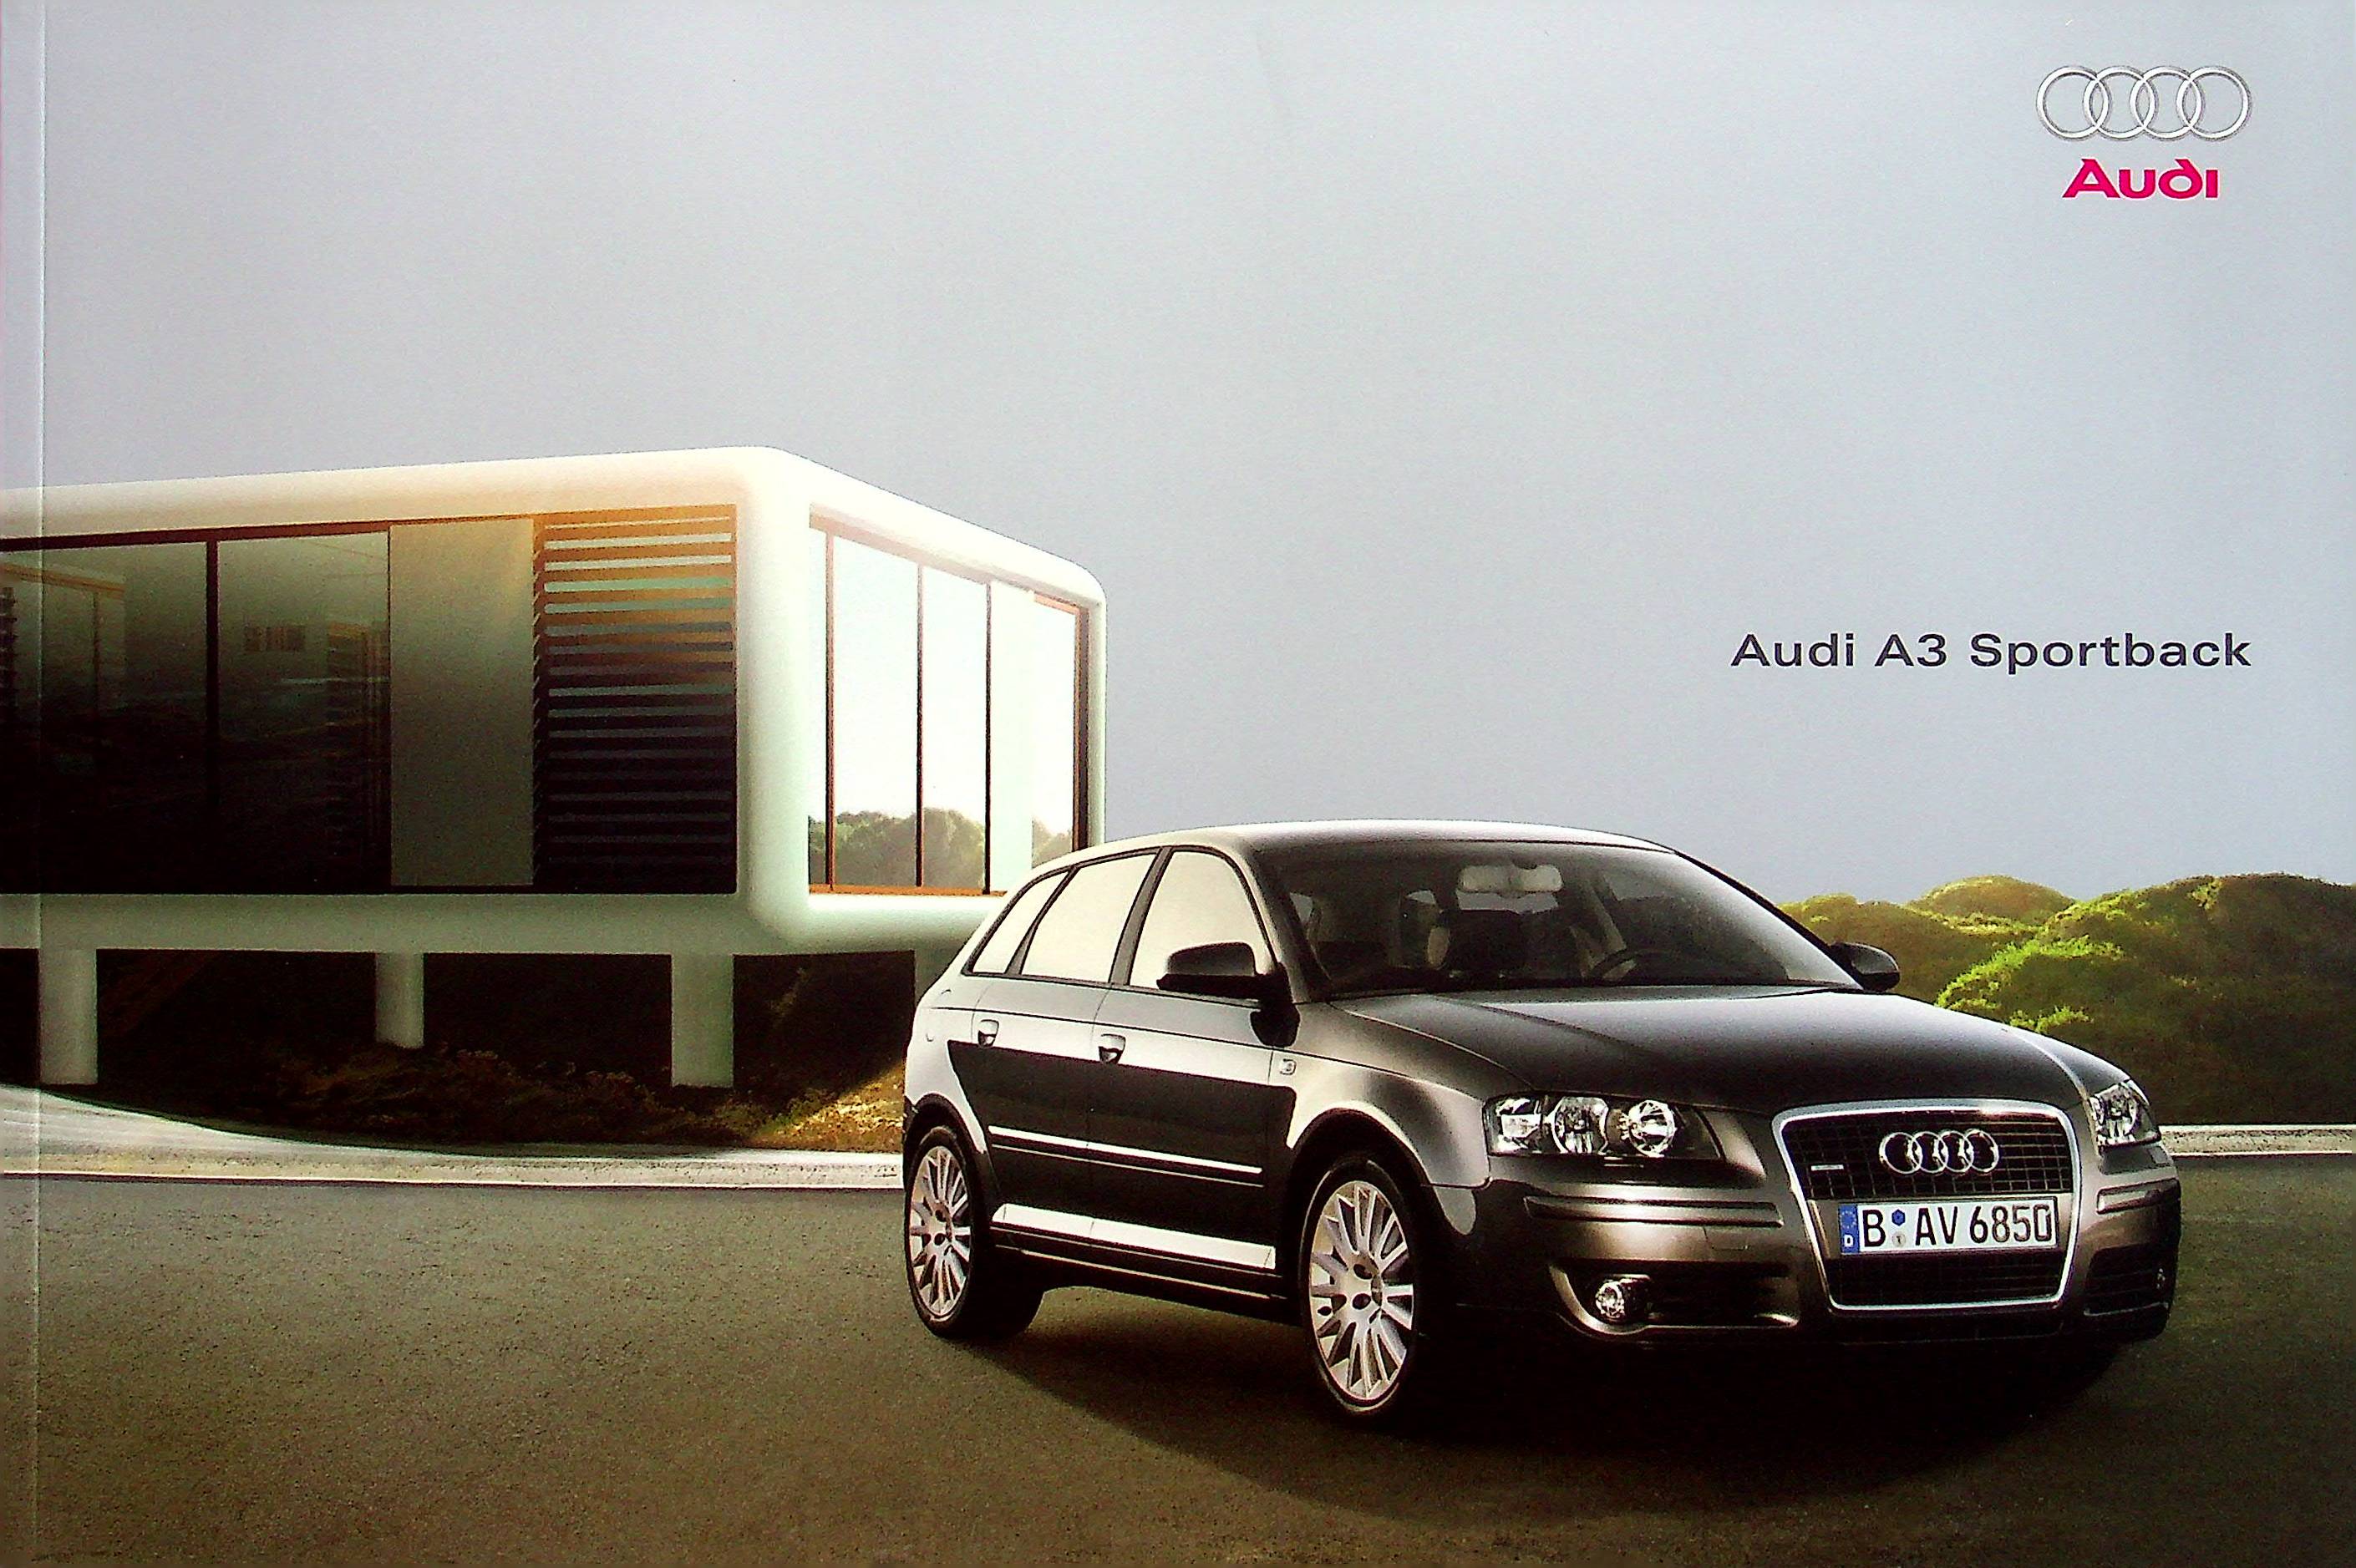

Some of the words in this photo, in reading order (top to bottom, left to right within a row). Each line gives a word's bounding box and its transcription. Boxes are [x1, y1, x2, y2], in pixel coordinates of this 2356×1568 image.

[2063, 159, 2218, 199] Audi
[1731, 633, 1854, 667] Audi
[1874, 633, 1947, 667] A3
[1970, 632, 2252, 675] Sportback
[1843, 1234, 1854, 1247] D
[1862, 1209, 1886, 1247] B
[1915, 1205, 1958, 1246] AV
[1969, 1204, 2053, 1244] 6850
